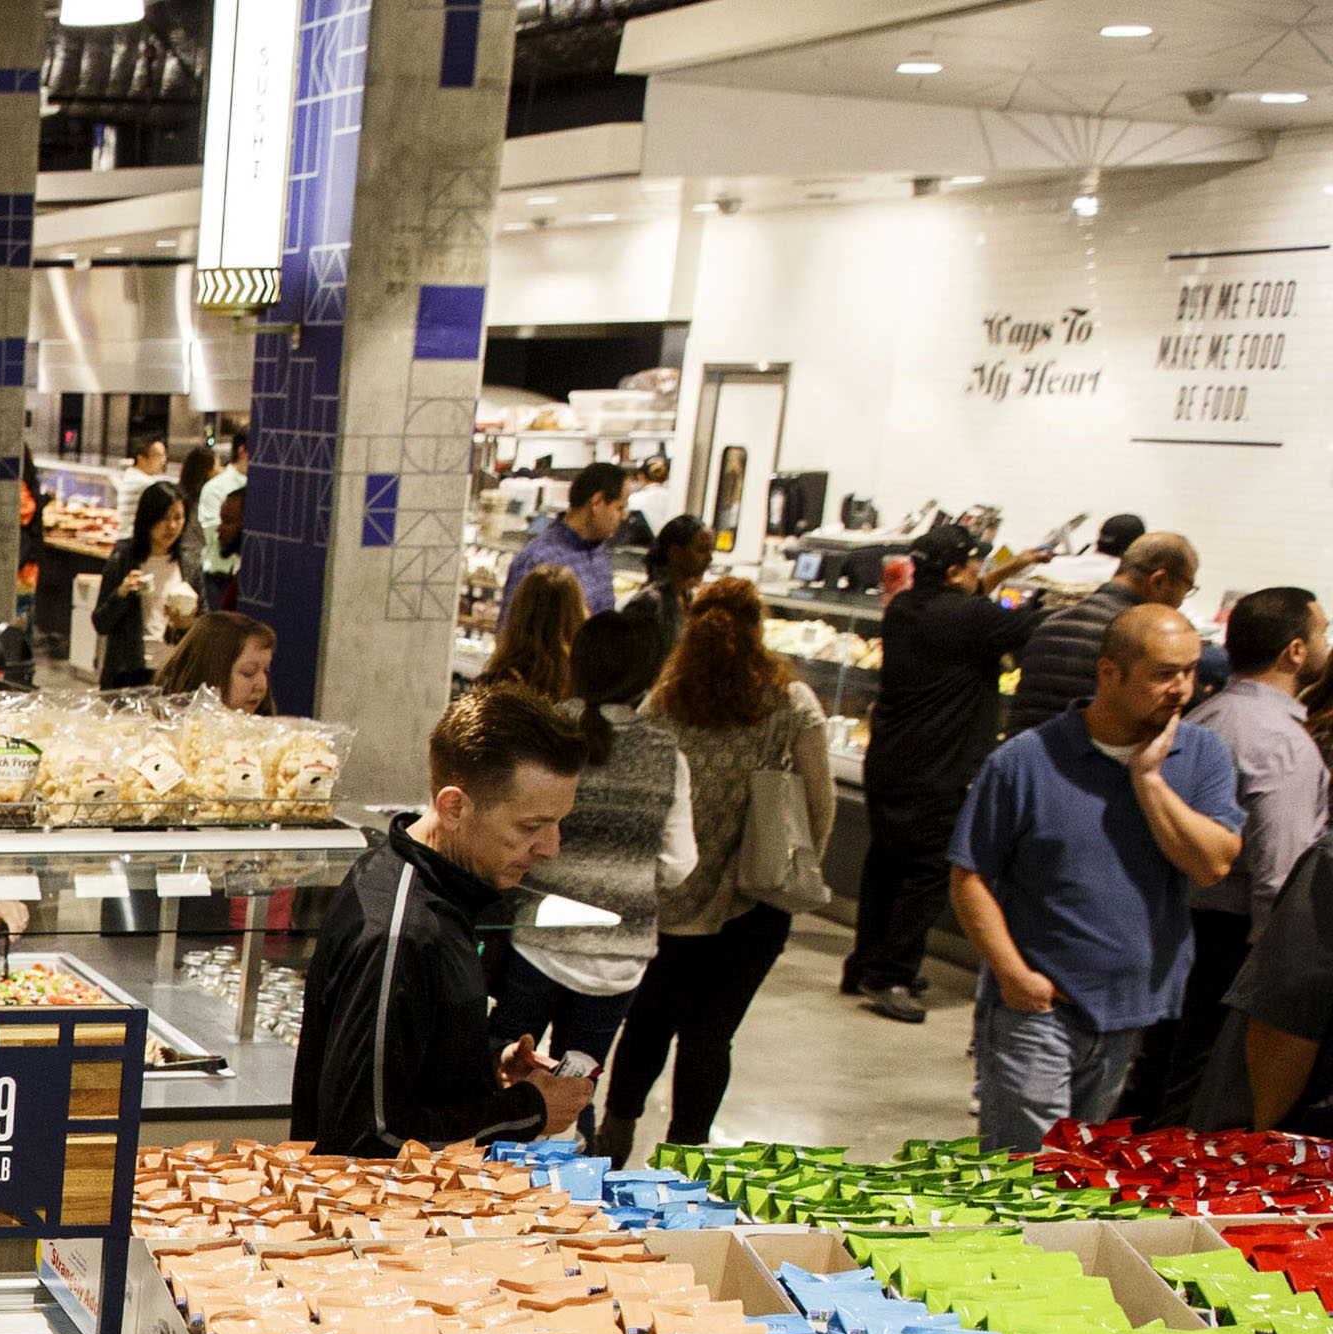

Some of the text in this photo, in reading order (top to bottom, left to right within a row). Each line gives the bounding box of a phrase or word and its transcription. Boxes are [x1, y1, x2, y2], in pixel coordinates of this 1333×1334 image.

[253, 46, 269, 179] SUSHI
[1214, 282, 1245, 319] ME
[983, 307, 1093, 352] Ways To
[1155, 334, 1203, 369] MAKE
[1204, 334, 1235, 369] ME
[966, 359, 1102, 402] My Heart
[1175, 386, 1198, 421] BE
